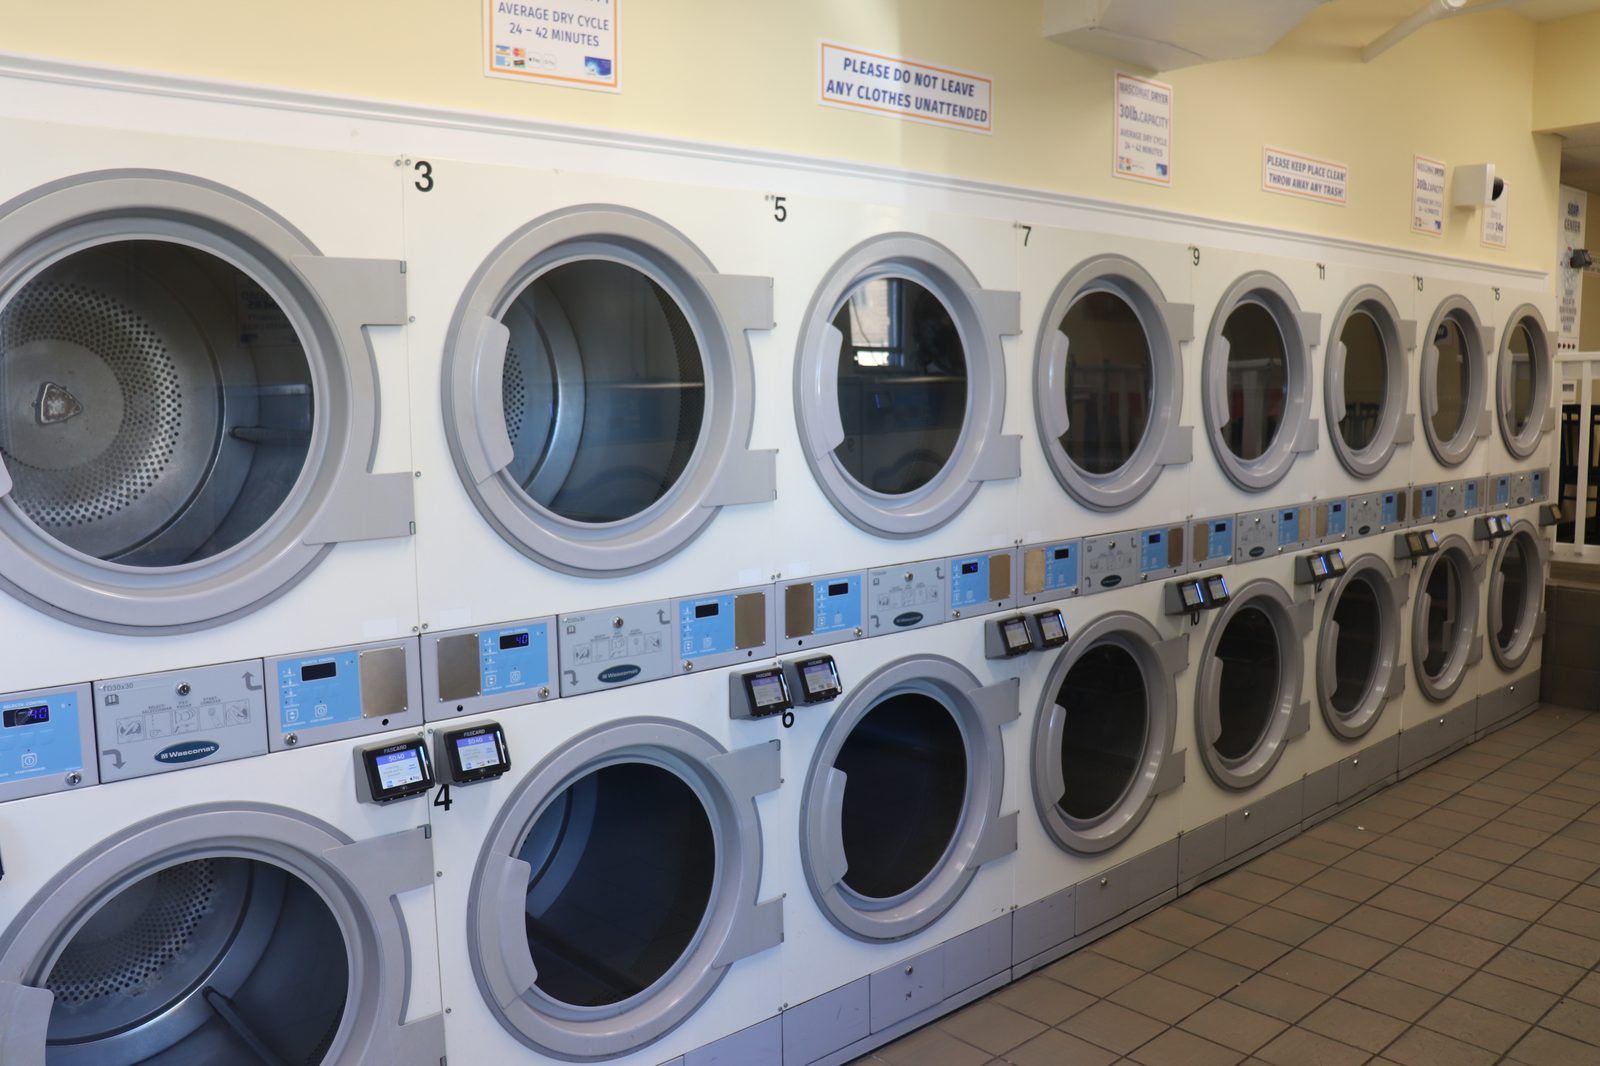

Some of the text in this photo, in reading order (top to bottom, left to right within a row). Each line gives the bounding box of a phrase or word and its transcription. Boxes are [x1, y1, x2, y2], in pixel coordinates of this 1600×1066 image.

[498, 2, 610, 31] AVERAGE DRY CYCLE
[509, 22, 523, 35] 24
[535, 27, 548, 39] 42
[551, 29, 600, 47] MINUTES
[843, 57, 975, 97] PLEASE DO NOT LEAVE
[826, 79, 988, 123] ANY CLOTHES UNATTENDED
[415, 161, 434, 192] 3
[1267, 155, 1290, 169] PLEASE
[1291, 160, 1307, 173] KEEP
[1307, 164, 1325, 178] PLACE
[1269, 172, 1292, 187] THROW
[1292, 178, 1310, 190] AWAY
[1310, 182, 1322, 193] ANY
[774, 197, 787, 223] 5
[1022, 226, 1032, 247] 7
[1193, 248, 1200, 266] 9
[1190, 609, 1200, 626] 10
[782, 711, 795, 728] 6
[169, 745, 216, 758] Wascomat
[433, 783, 453, 811] 4
